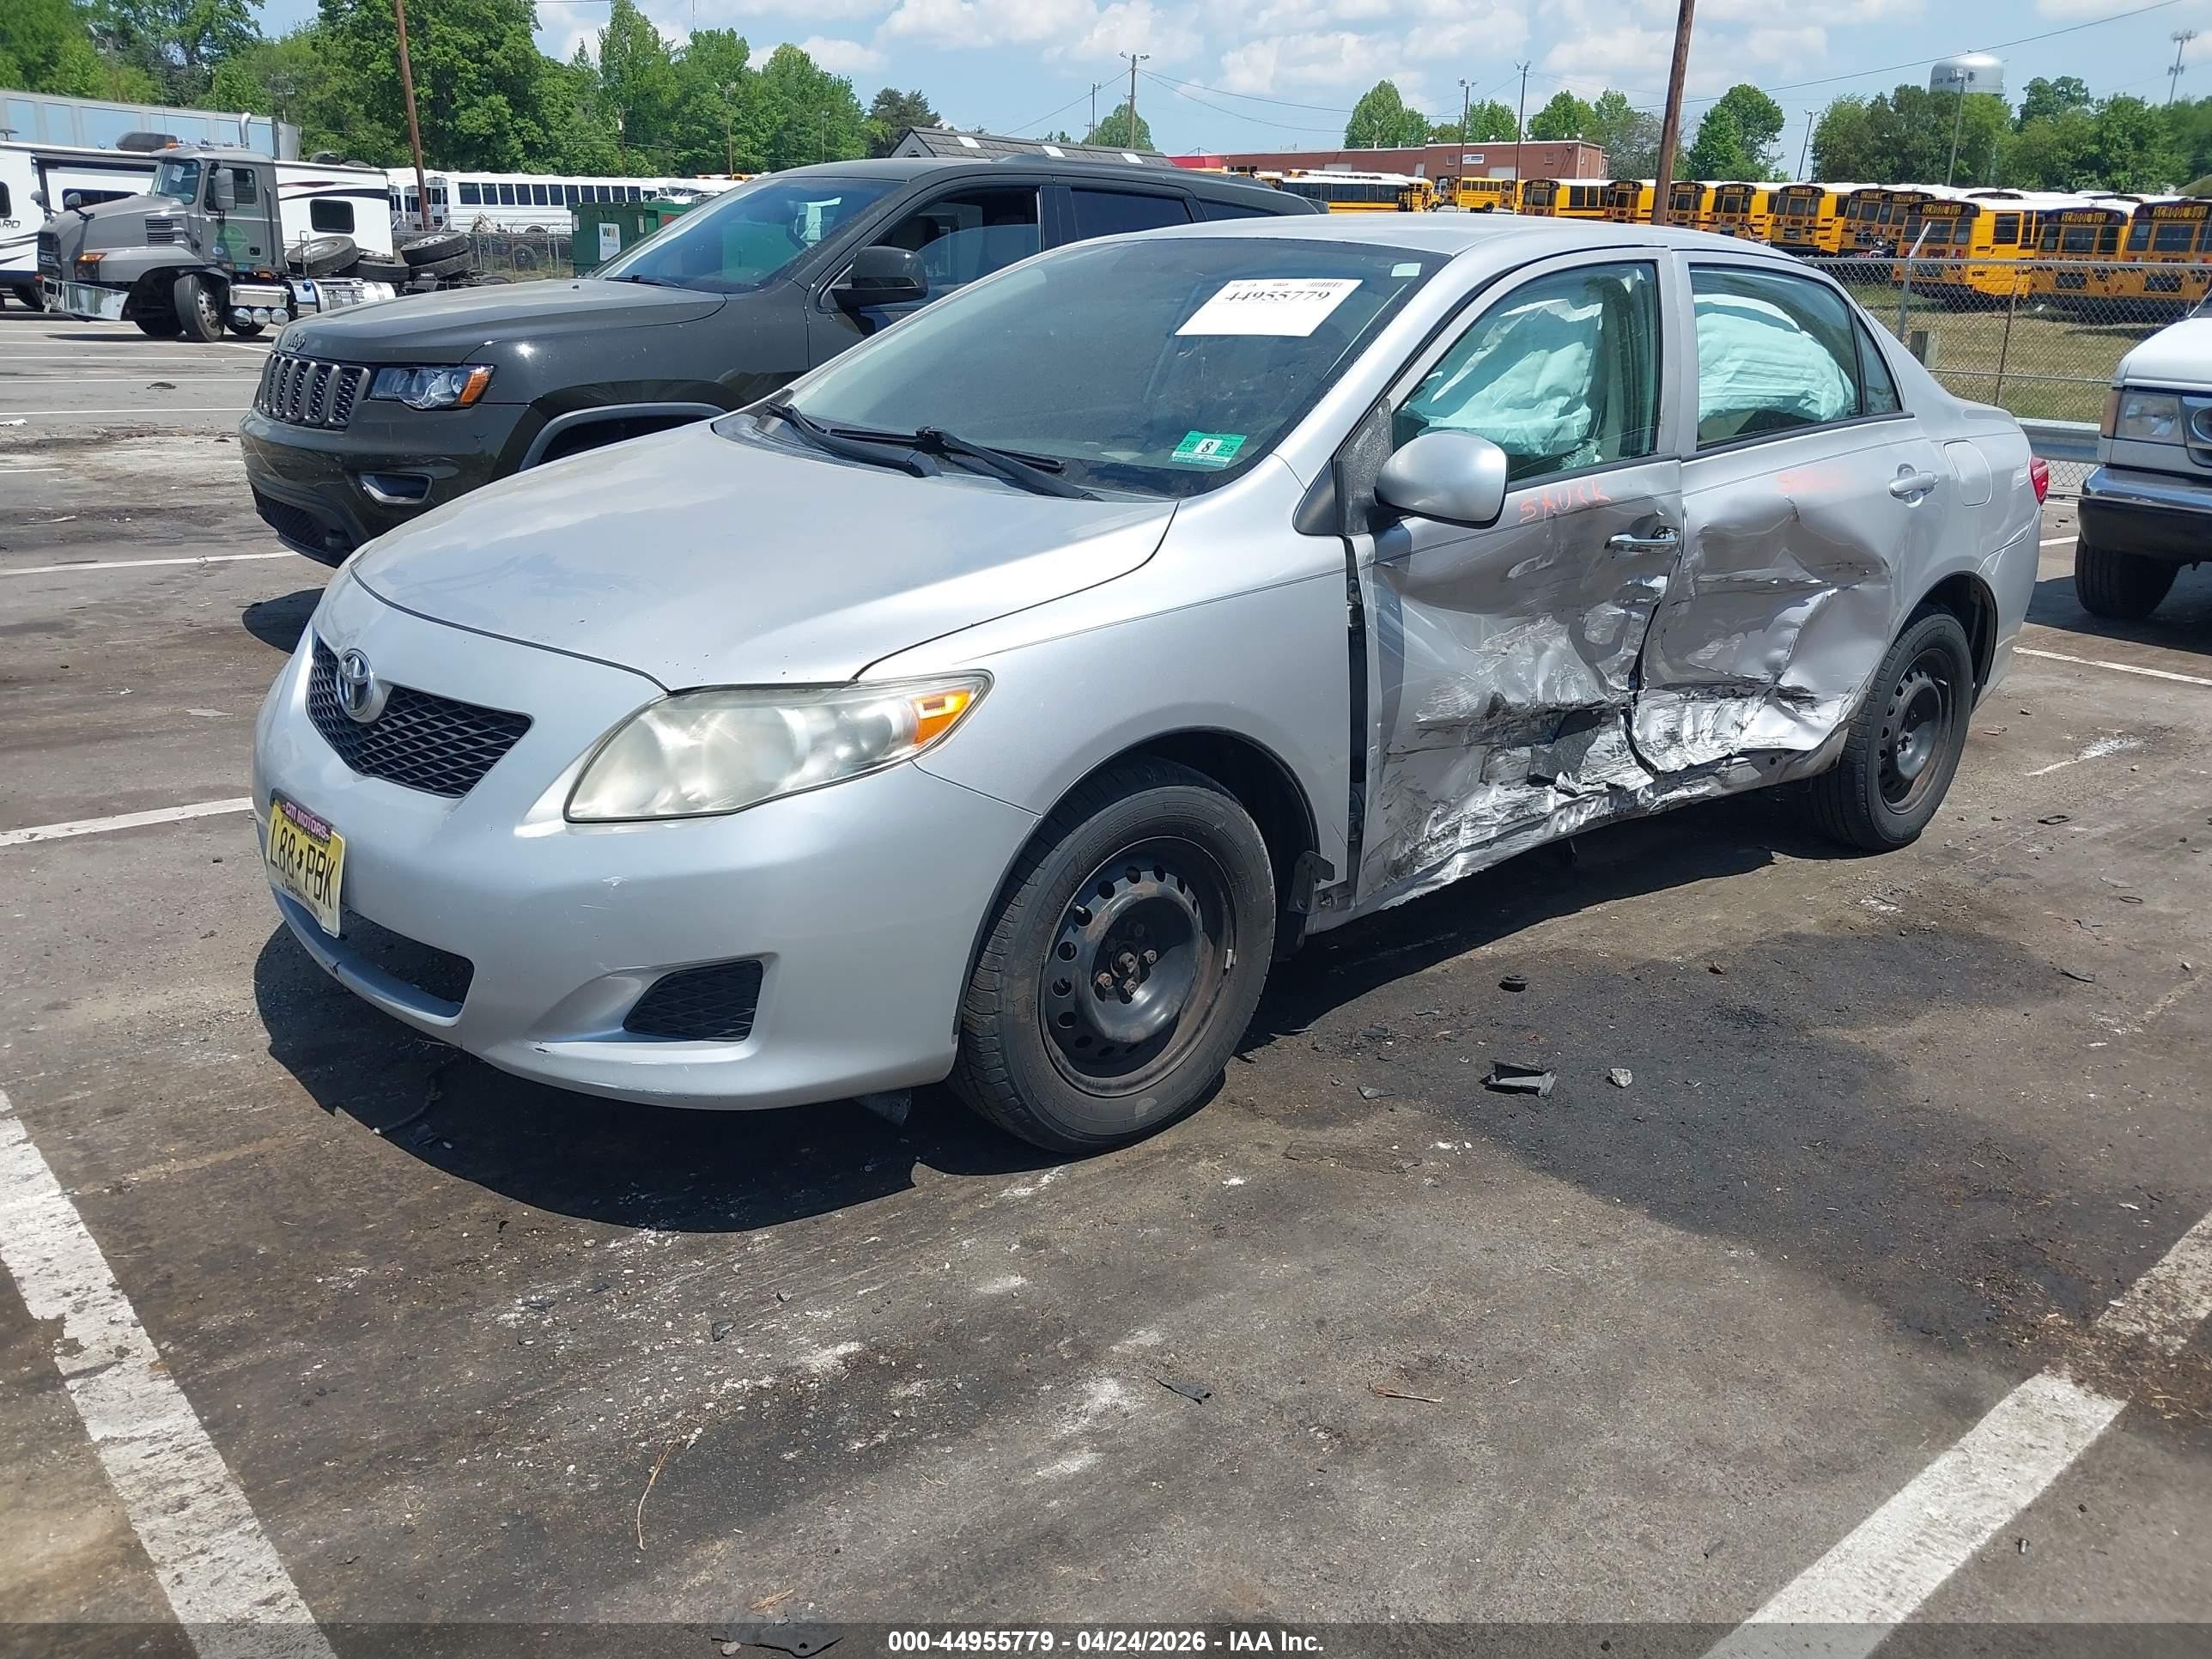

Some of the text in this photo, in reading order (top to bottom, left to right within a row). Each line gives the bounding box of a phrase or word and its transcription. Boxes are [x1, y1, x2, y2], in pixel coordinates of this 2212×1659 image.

[2062, 212, 2091, 223] SCHOOL
[2154, 206, 2188, 218] SCHOOL
[1224, 291, 1330, 301] 44955779
[1201, 441, 1214, 453] 8
[1219, 444, 1237, 453] 25
[296, 809, 327, 840] MOTORS
[304, 843, 337, 910] PBK
